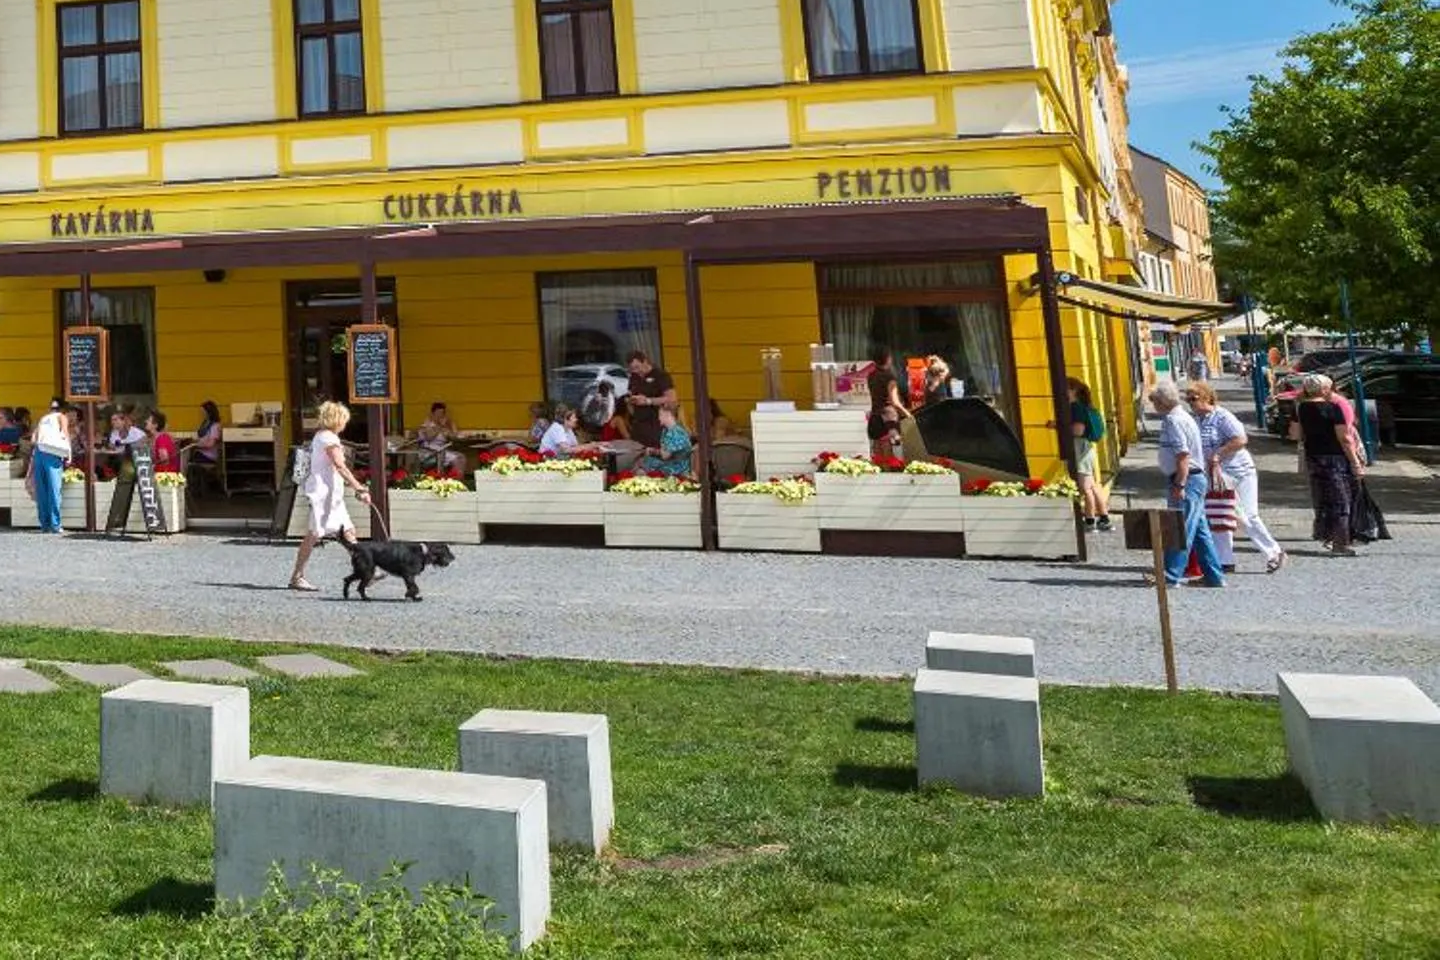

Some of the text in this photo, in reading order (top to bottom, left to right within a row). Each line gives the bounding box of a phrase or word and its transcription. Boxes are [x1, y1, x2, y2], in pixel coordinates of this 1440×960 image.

[817, 165, 951, 198] PENZION
[383, 183, 522, 220] CUKRÁRNA
[51, 205, 154, 236] KAVÁRNA
